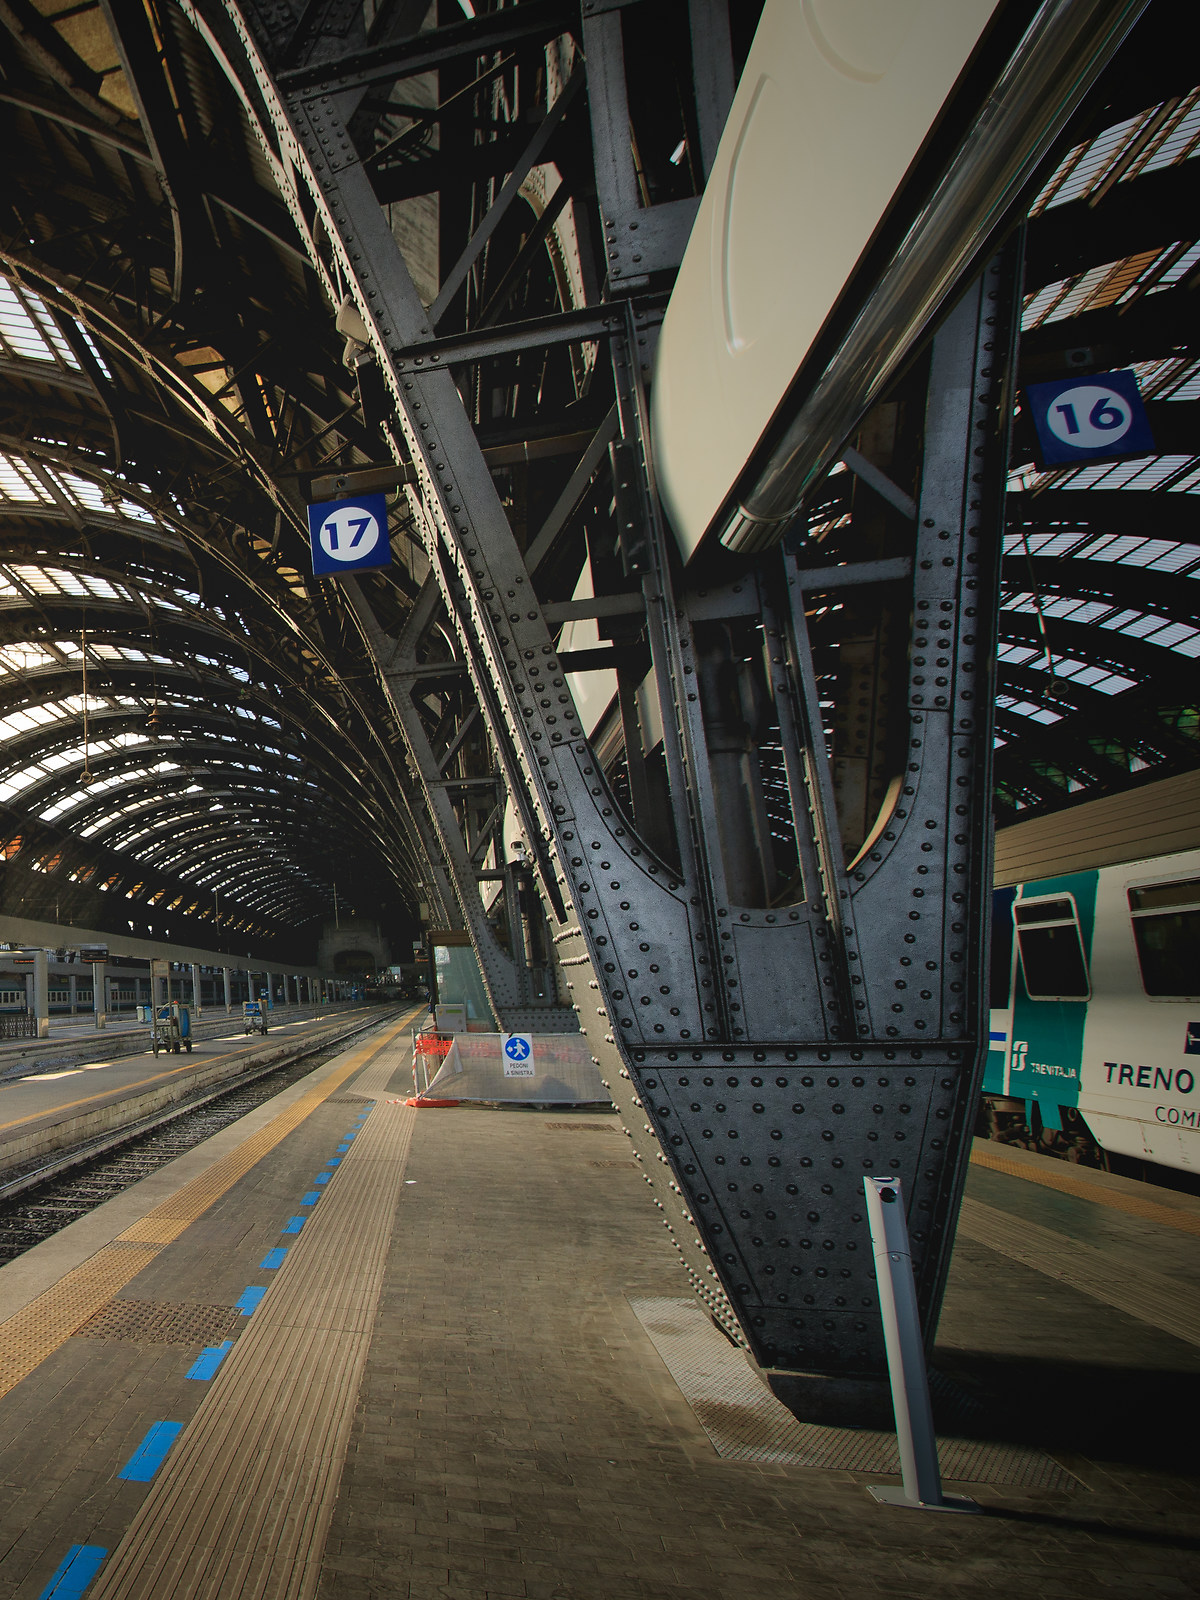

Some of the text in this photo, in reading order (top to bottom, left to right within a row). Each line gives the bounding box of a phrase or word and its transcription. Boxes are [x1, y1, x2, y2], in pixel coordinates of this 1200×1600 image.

[1055, 397, 1125, 434] 16
[324, 516, 372, 551] 17
[1030, 1062, 1077, 1079] TRENITALIA
[1103, 1061, 1195, 1095] TRENO
